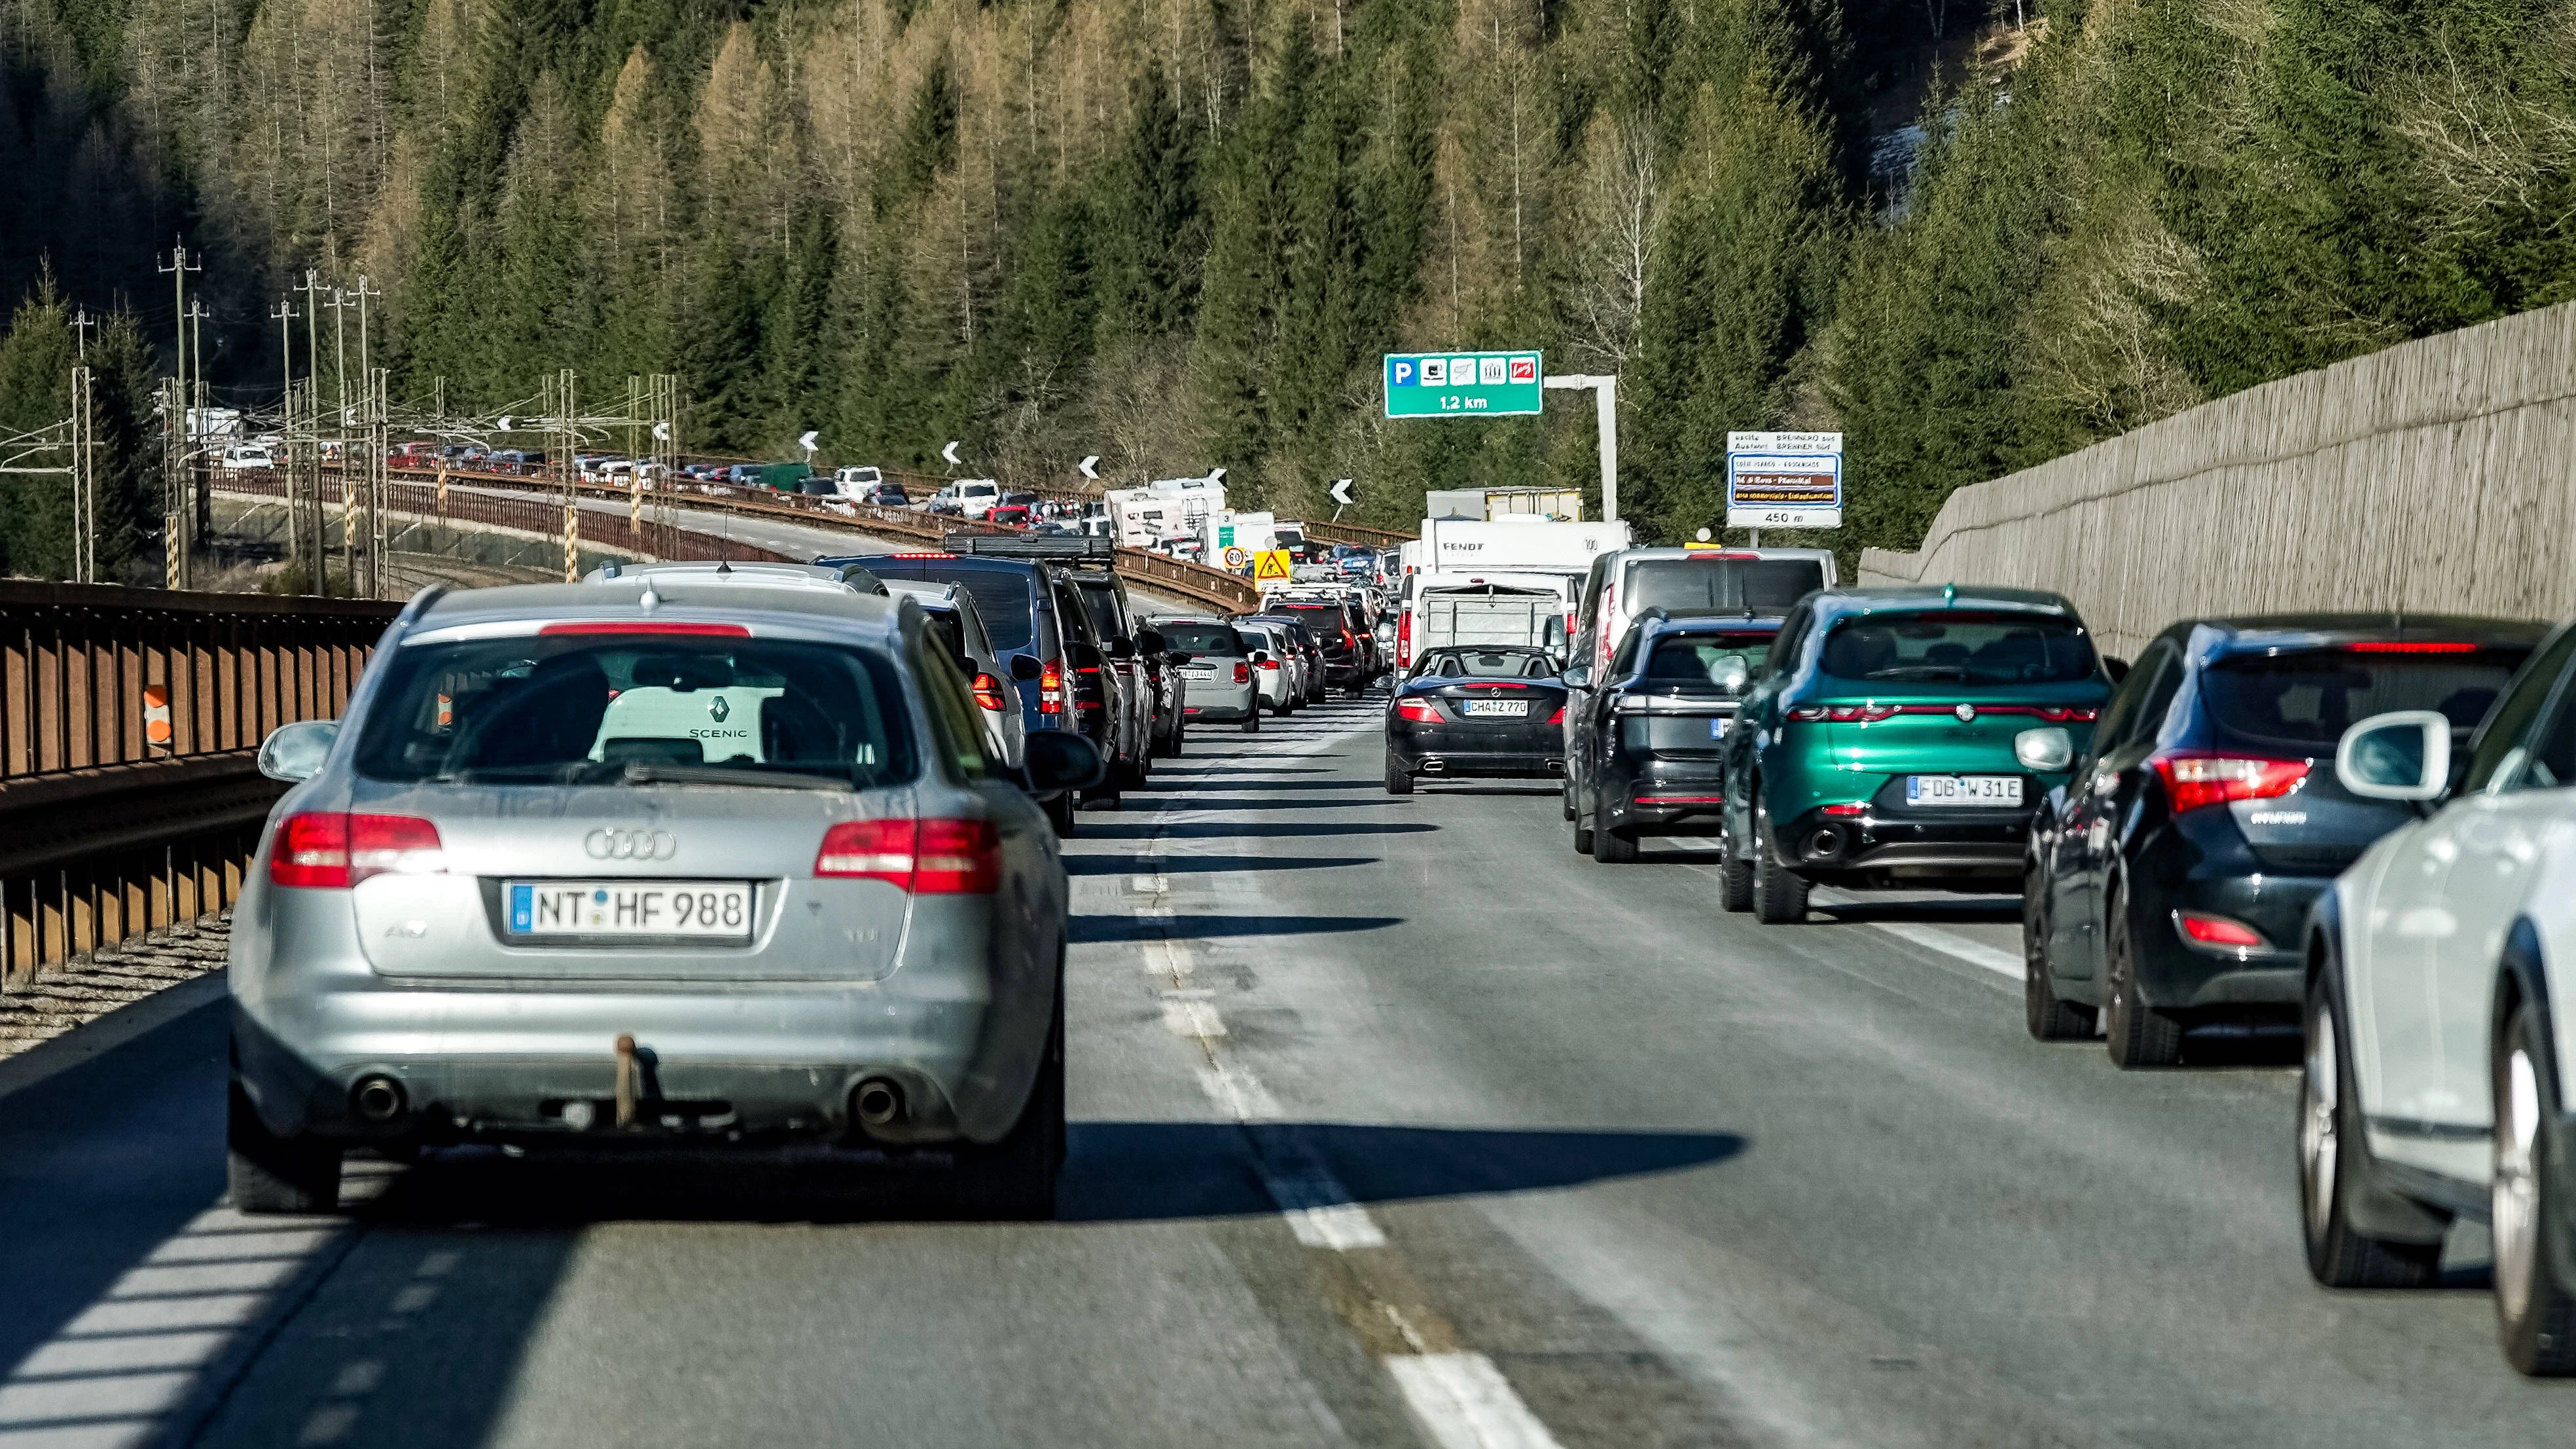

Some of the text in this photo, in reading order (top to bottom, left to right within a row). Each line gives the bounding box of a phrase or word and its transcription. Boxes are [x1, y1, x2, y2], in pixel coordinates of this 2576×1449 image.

[1465, 396, 1488, 409] km
[1766, 513, 1788, 522] 450
[1230, 553, 1240, 562] 60
[1471, 702, 1526, 712] CHA Z 770
[689, 729, 747, 738] SCENIC
[540, 892, 742, 927] NT HF 988
